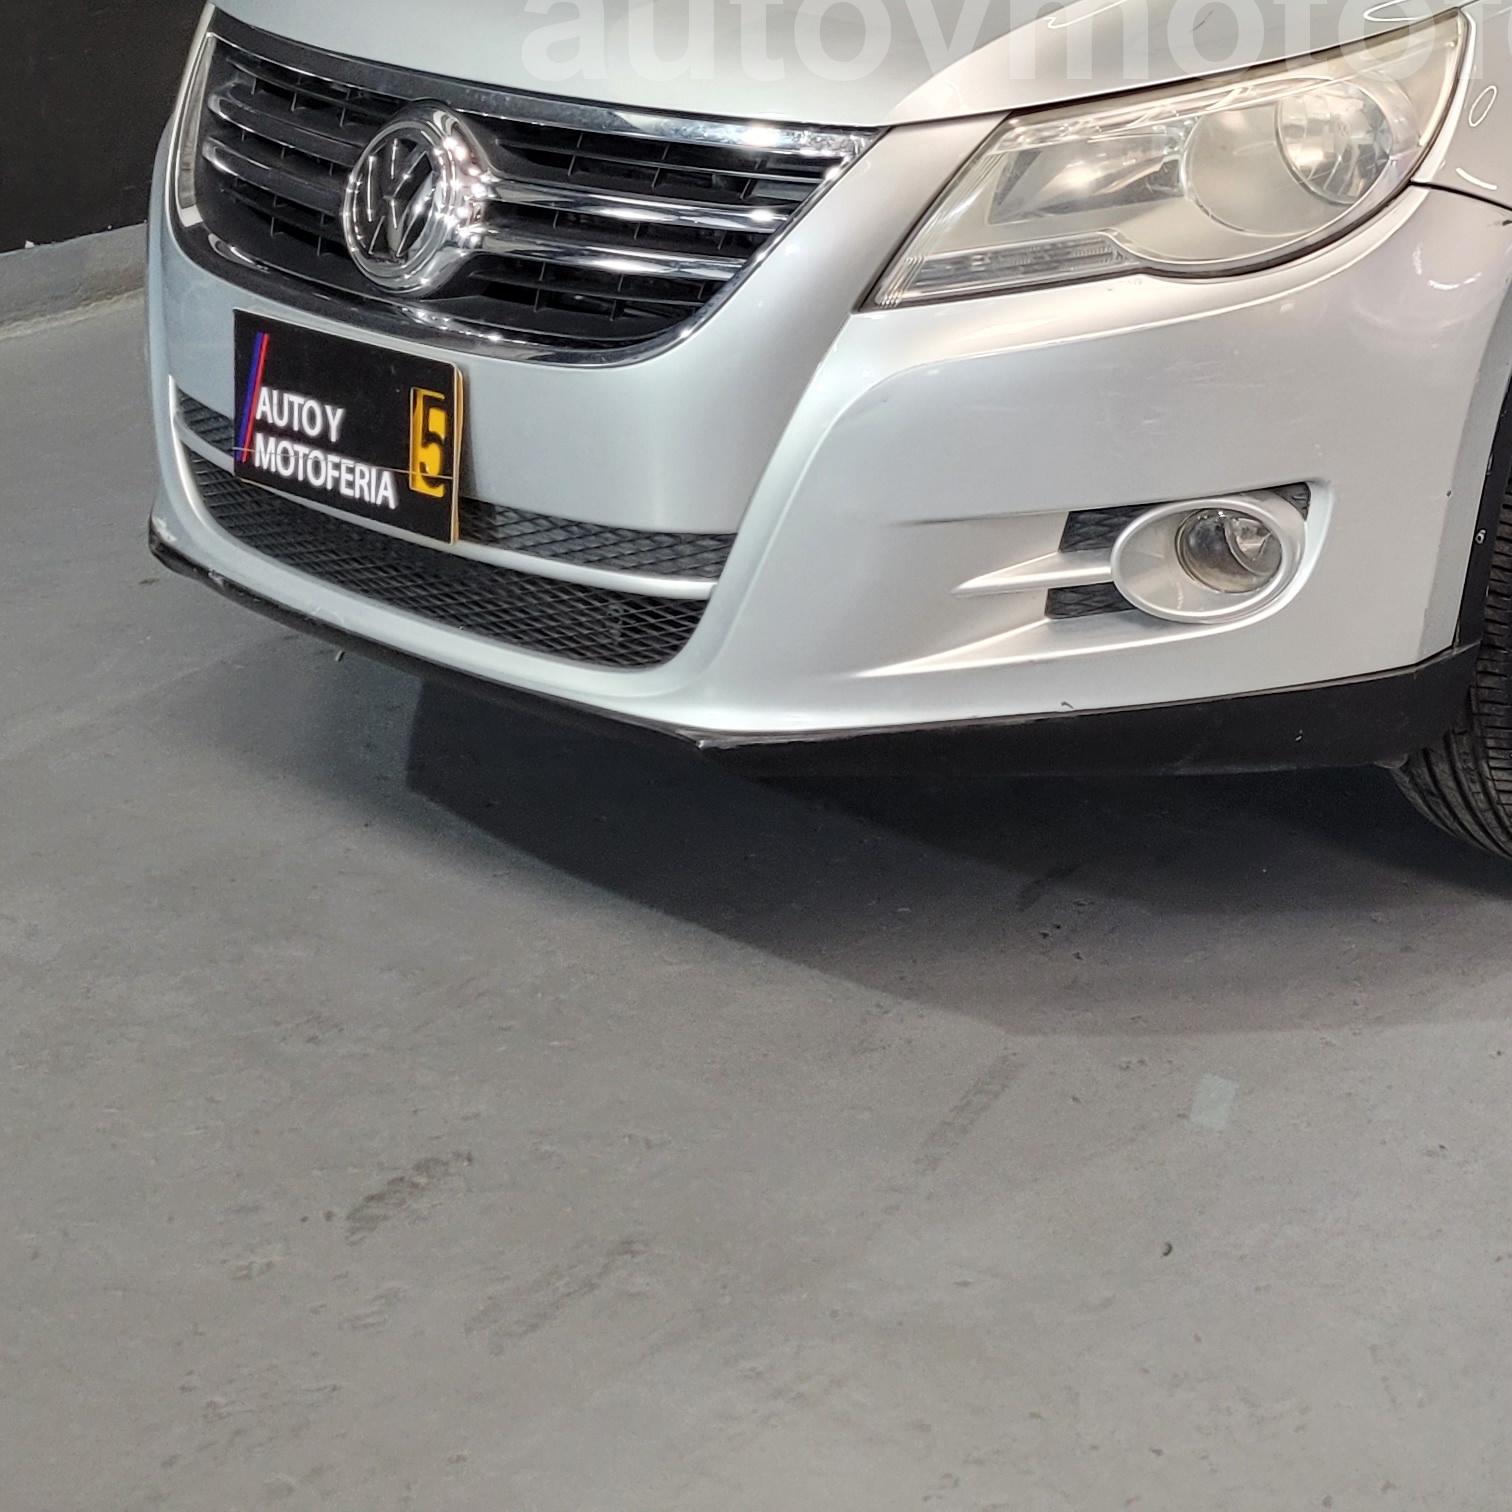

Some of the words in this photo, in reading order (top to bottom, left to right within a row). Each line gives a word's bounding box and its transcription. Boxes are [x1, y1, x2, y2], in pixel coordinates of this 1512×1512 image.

[255, 386, 323, 437] AUTO
[324, 404, 344, 442] Y
[254, 432, 396, 510] MOTOFERIA
